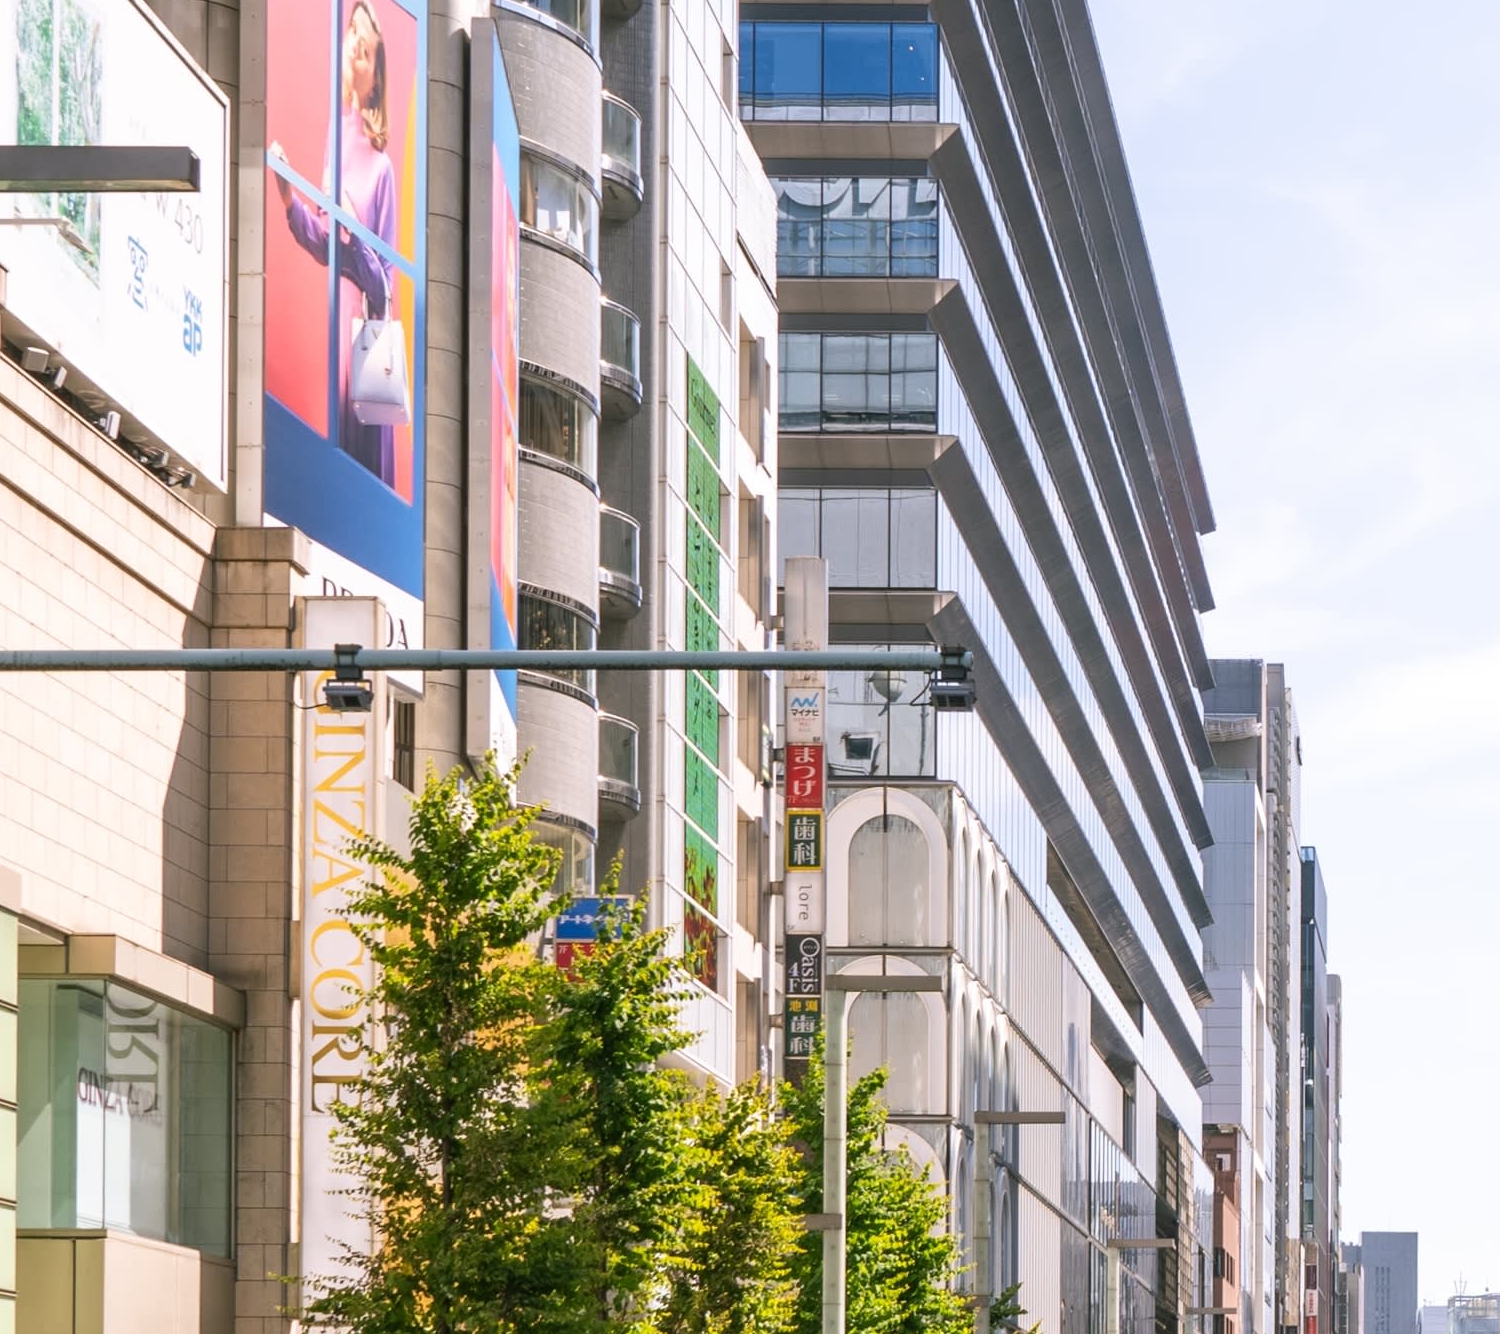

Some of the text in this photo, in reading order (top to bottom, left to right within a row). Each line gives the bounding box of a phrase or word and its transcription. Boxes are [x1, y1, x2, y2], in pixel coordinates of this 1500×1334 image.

[791, 708, 820, 717] マイナビ
[792, 746, 817, 797] まつげ
[793, 816, 817, 865] 歯科
[798, 883, 813, 921] lore
[800, 938, 820, 993] Oasis
[310, 920, 364, 1114] CORE
[790, 1015, 816, 1056] 歯科
